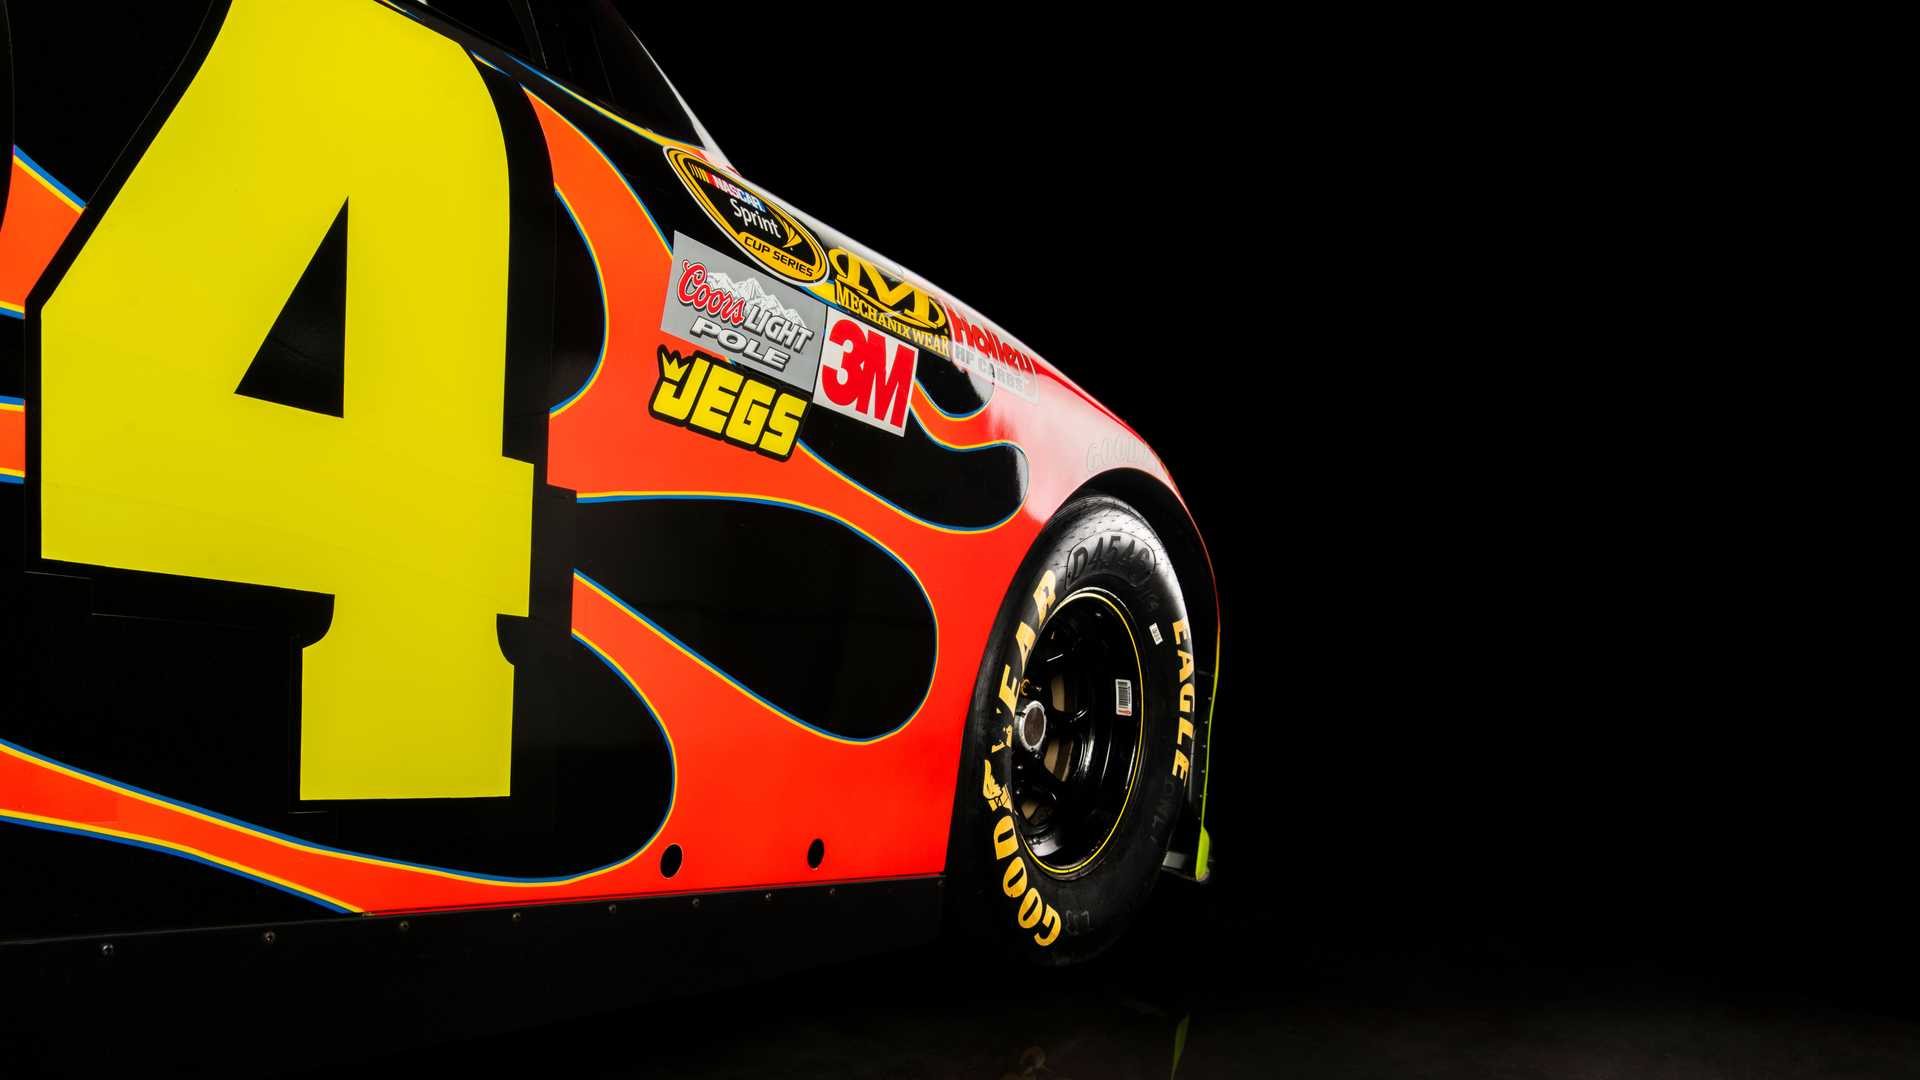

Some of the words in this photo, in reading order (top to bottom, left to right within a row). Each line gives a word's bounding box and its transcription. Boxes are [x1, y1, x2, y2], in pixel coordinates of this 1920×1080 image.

[711, 173, 768, 214] NASCAR
[729, 197, 782, 239] Sprint
[743, 235, 771, 258] CUP
[773, 250, 815, 278] SERIES
[676, 259, 745, 326] Coors
[743, 304, 815, 353] LIGHT
[689, 316, 790, 372] POLE
[834, 279, 912, 340] MECHANIX
[911, 328, 951, 358] WEAR
[946, 305, 1036, 376] Holley
[41, 0, 534, 800] 4
[650, 352, 809, 459] JEGS
[821, 317, 916, 429] 3M
[1171, 617, 1196, 788] EAGLE
